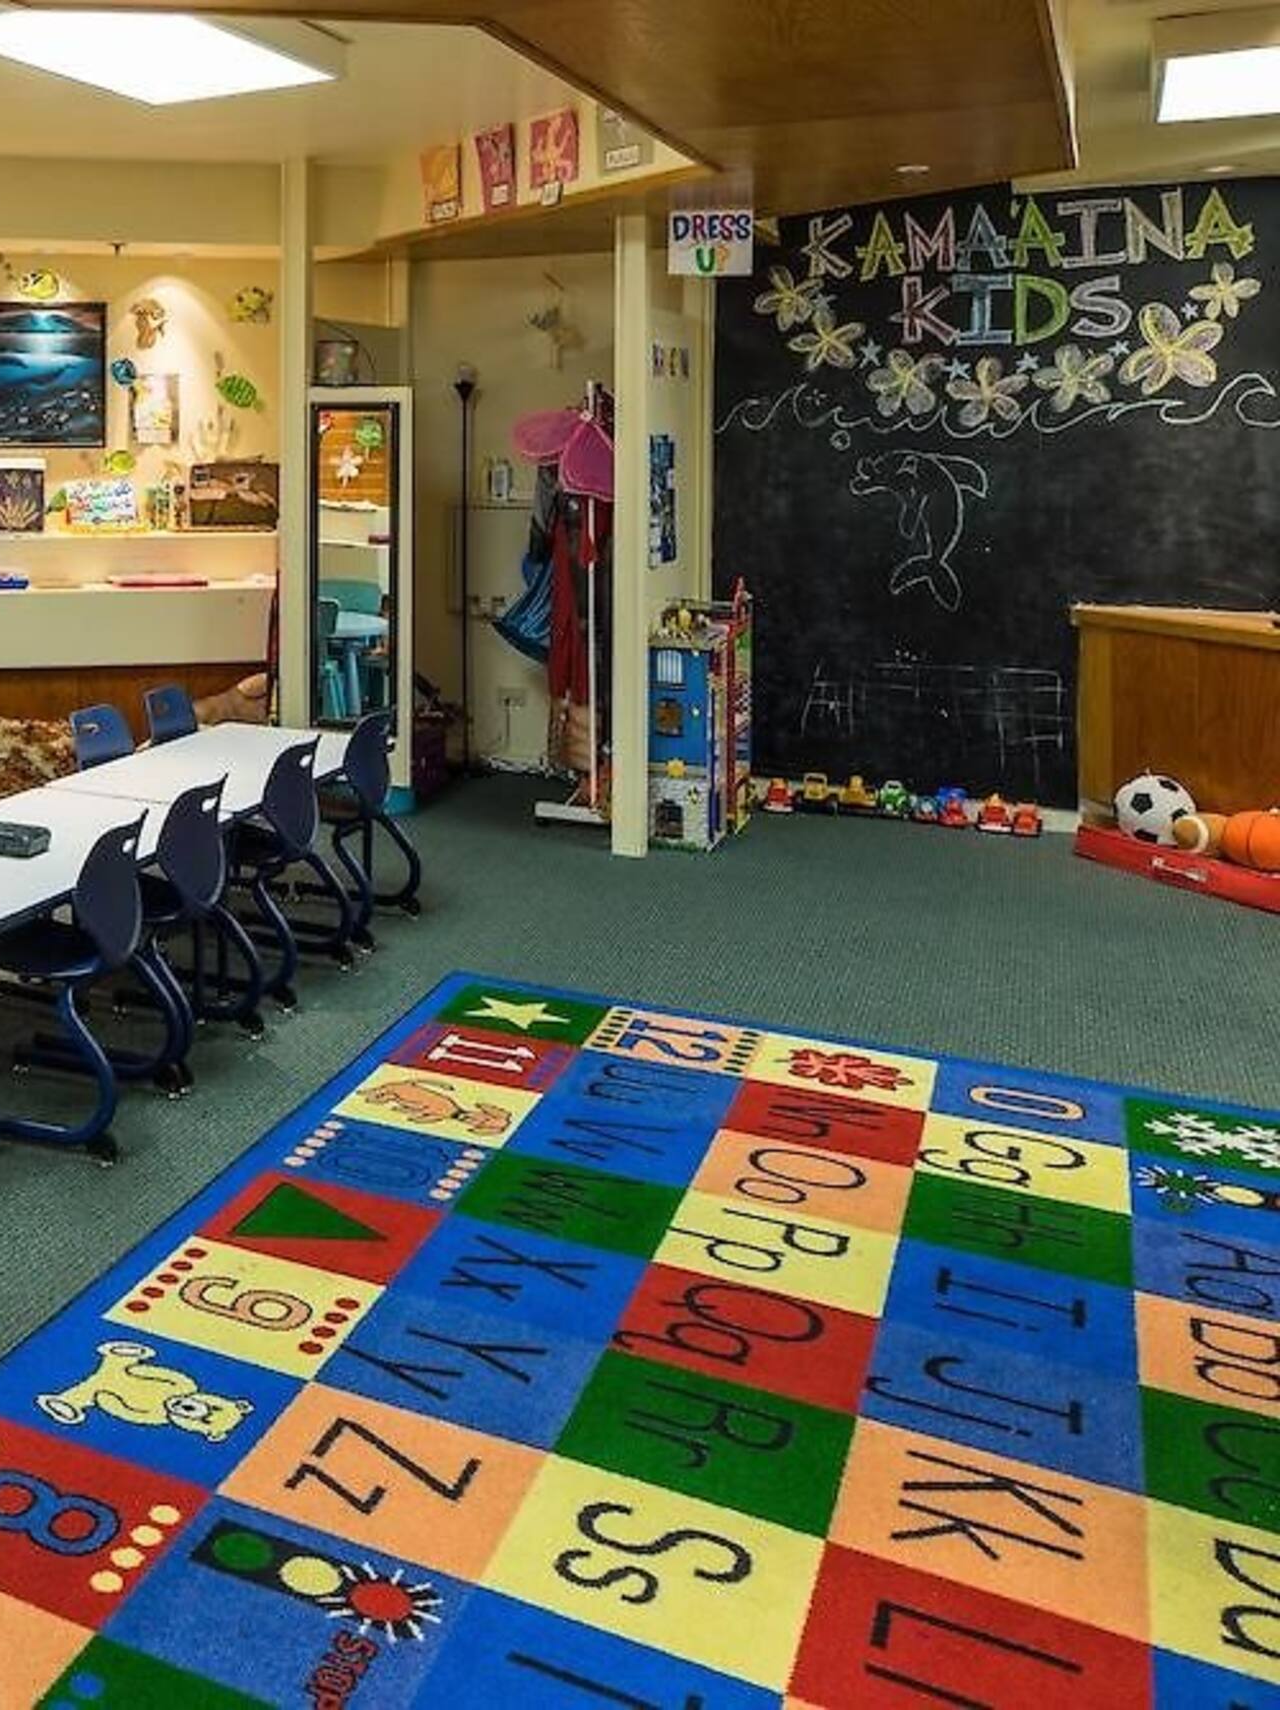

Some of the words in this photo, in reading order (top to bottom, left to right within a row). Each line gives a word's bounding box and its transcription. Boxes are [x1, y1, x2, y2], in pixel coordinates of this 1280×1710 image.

[673, 213, 751, 241] DRESS
[695, 245, 730, 272] UP
[890, 272, 1132, 346] KIDS
[616, 1019, 729, 1062] 12
[920, 1129, 1087, 1188] Gg
[667, 1207, 851, 1272] Pp
[612, 1283, 824, 1367] Qq
[340, 1327, 548, 1400] Yy
[623, 1379, 795, 1470] Rr
[284, 1416, 483, 1515] Zz
[890, 1449, 1085, 1562] Kk
[554, 1502, 753, 1605] Ss
